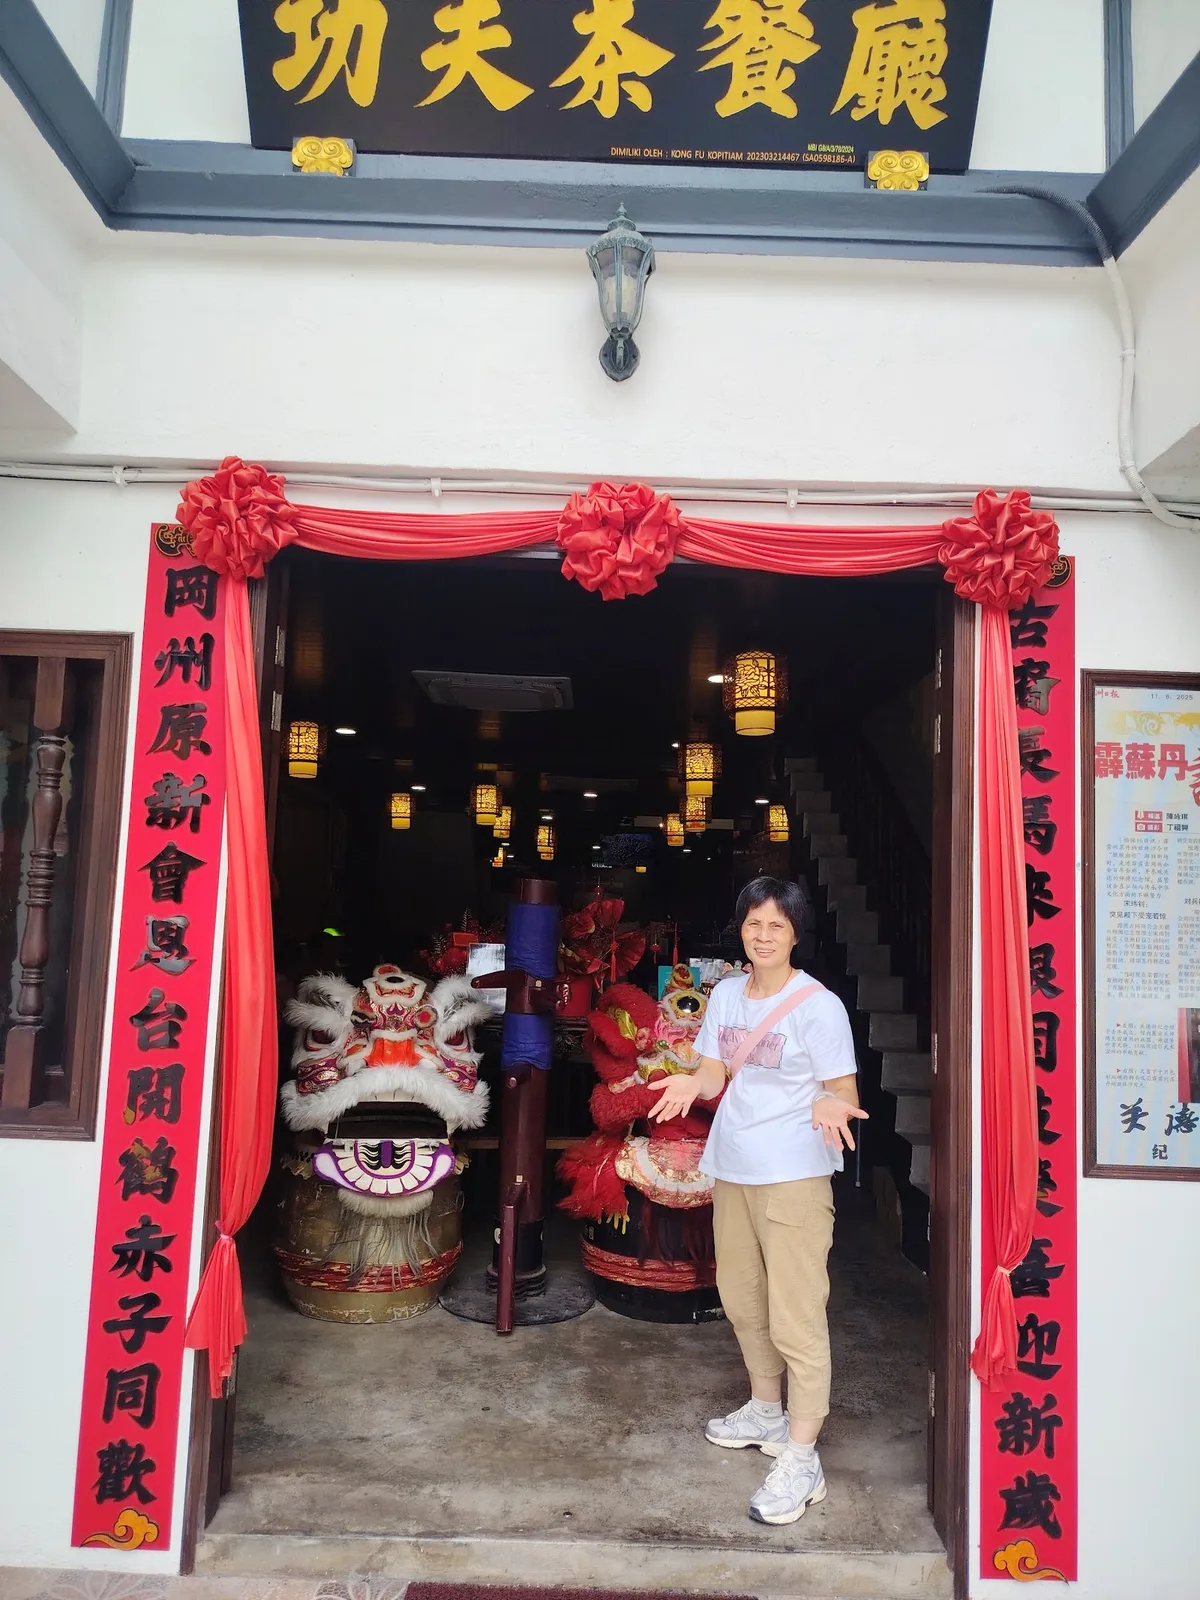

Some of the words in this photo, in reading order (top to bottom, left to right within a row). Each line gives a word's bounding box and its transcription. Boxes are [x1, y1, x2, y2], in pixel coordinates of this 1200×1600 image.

[272, 0, 948, 130] 功夫茶餐廳
[611, 147, 641, 156] DIMILIKI
[643, 148, 663, 158] OLEH
[671, 149, 692, 159] KONG
[695, 150, 704, 159] FU
[708, 151, 743, 161] KOPITIAM
[746, 152, 800, 161] 202303214467
[802, 153, 856, 163] (SA0598186-A)
[1152, 1144, 1169, 1160] 纪
